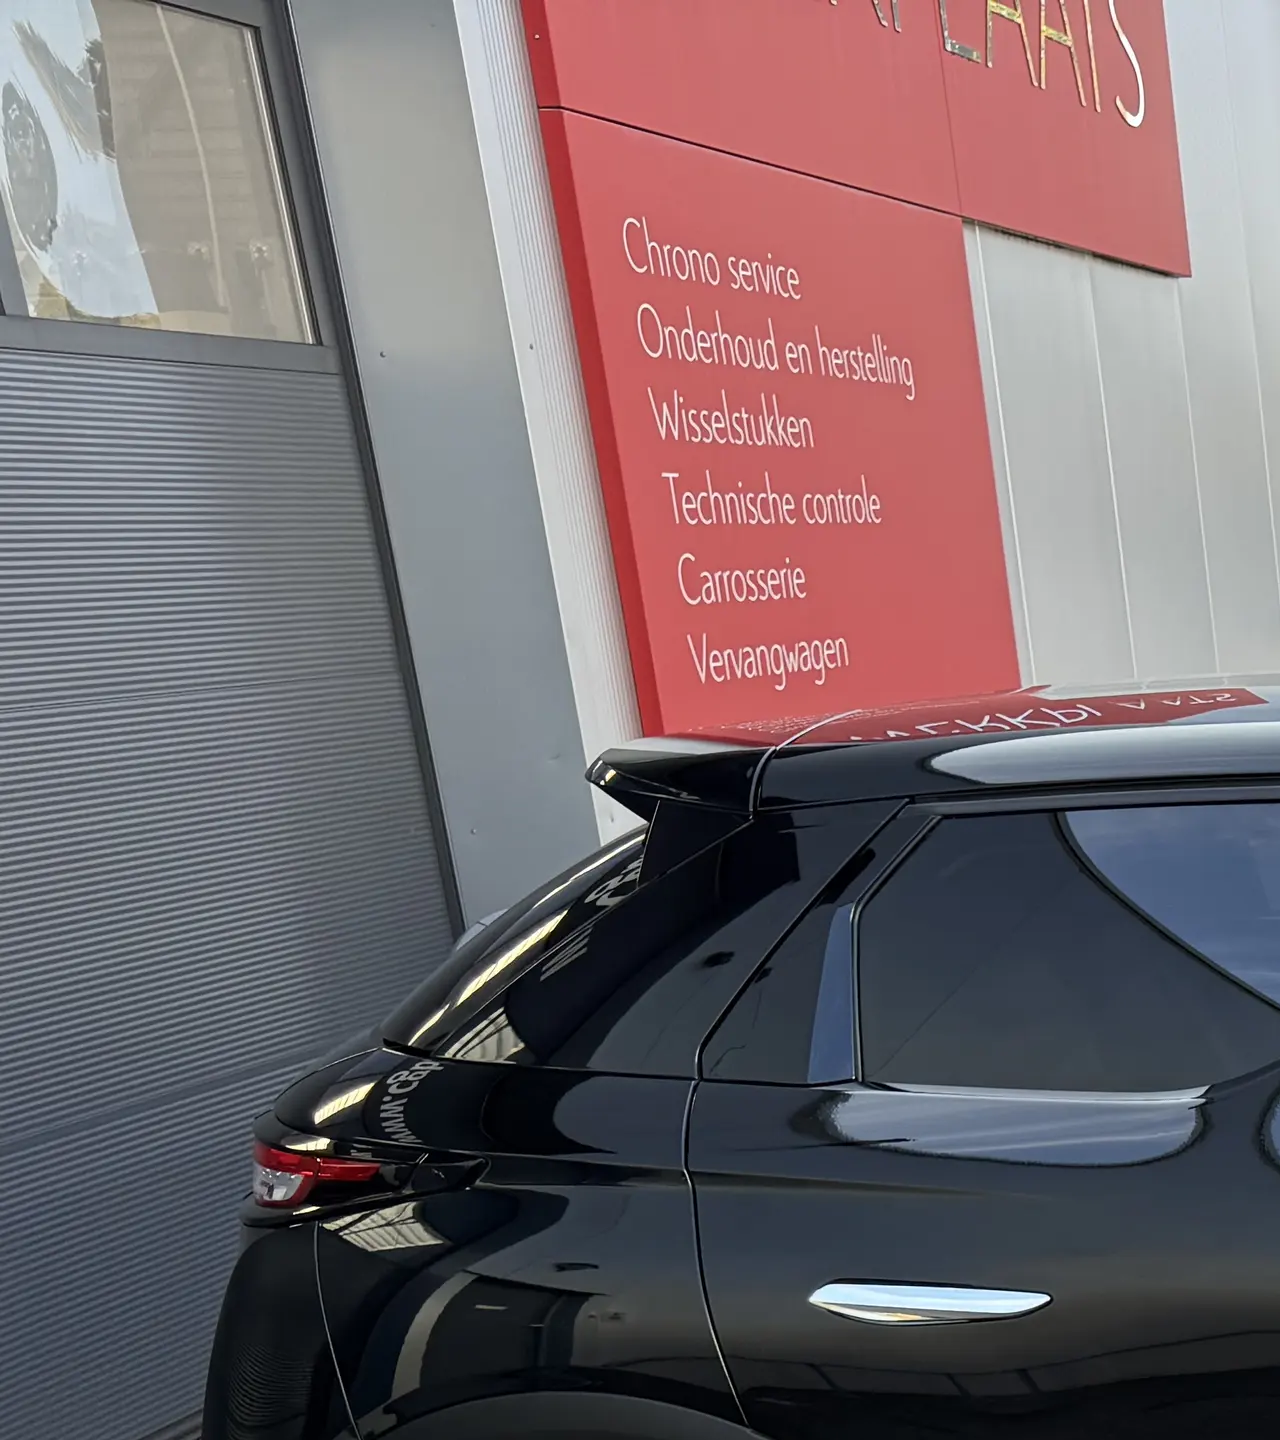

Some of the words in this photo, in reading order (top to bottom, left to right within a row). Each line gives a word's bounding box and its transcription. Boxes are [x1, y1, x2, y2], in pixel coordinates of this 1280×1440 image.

[622, 216, 720, 285] Chrono
[728, 253, 801, 299] service
[637, 303, 779, 371] Onderhoud
[786, 341, 813, 374] en
[814, 325, 915, 400] herstelling
[648, 387, 814, 448] Wisselstukken
[661, 469, 797, 525] Technische
[802, 474, 882, 524] controle
[677, 553, 807, 605] Carrosserie
[686, 633, 849, 691] Vervangwagen
